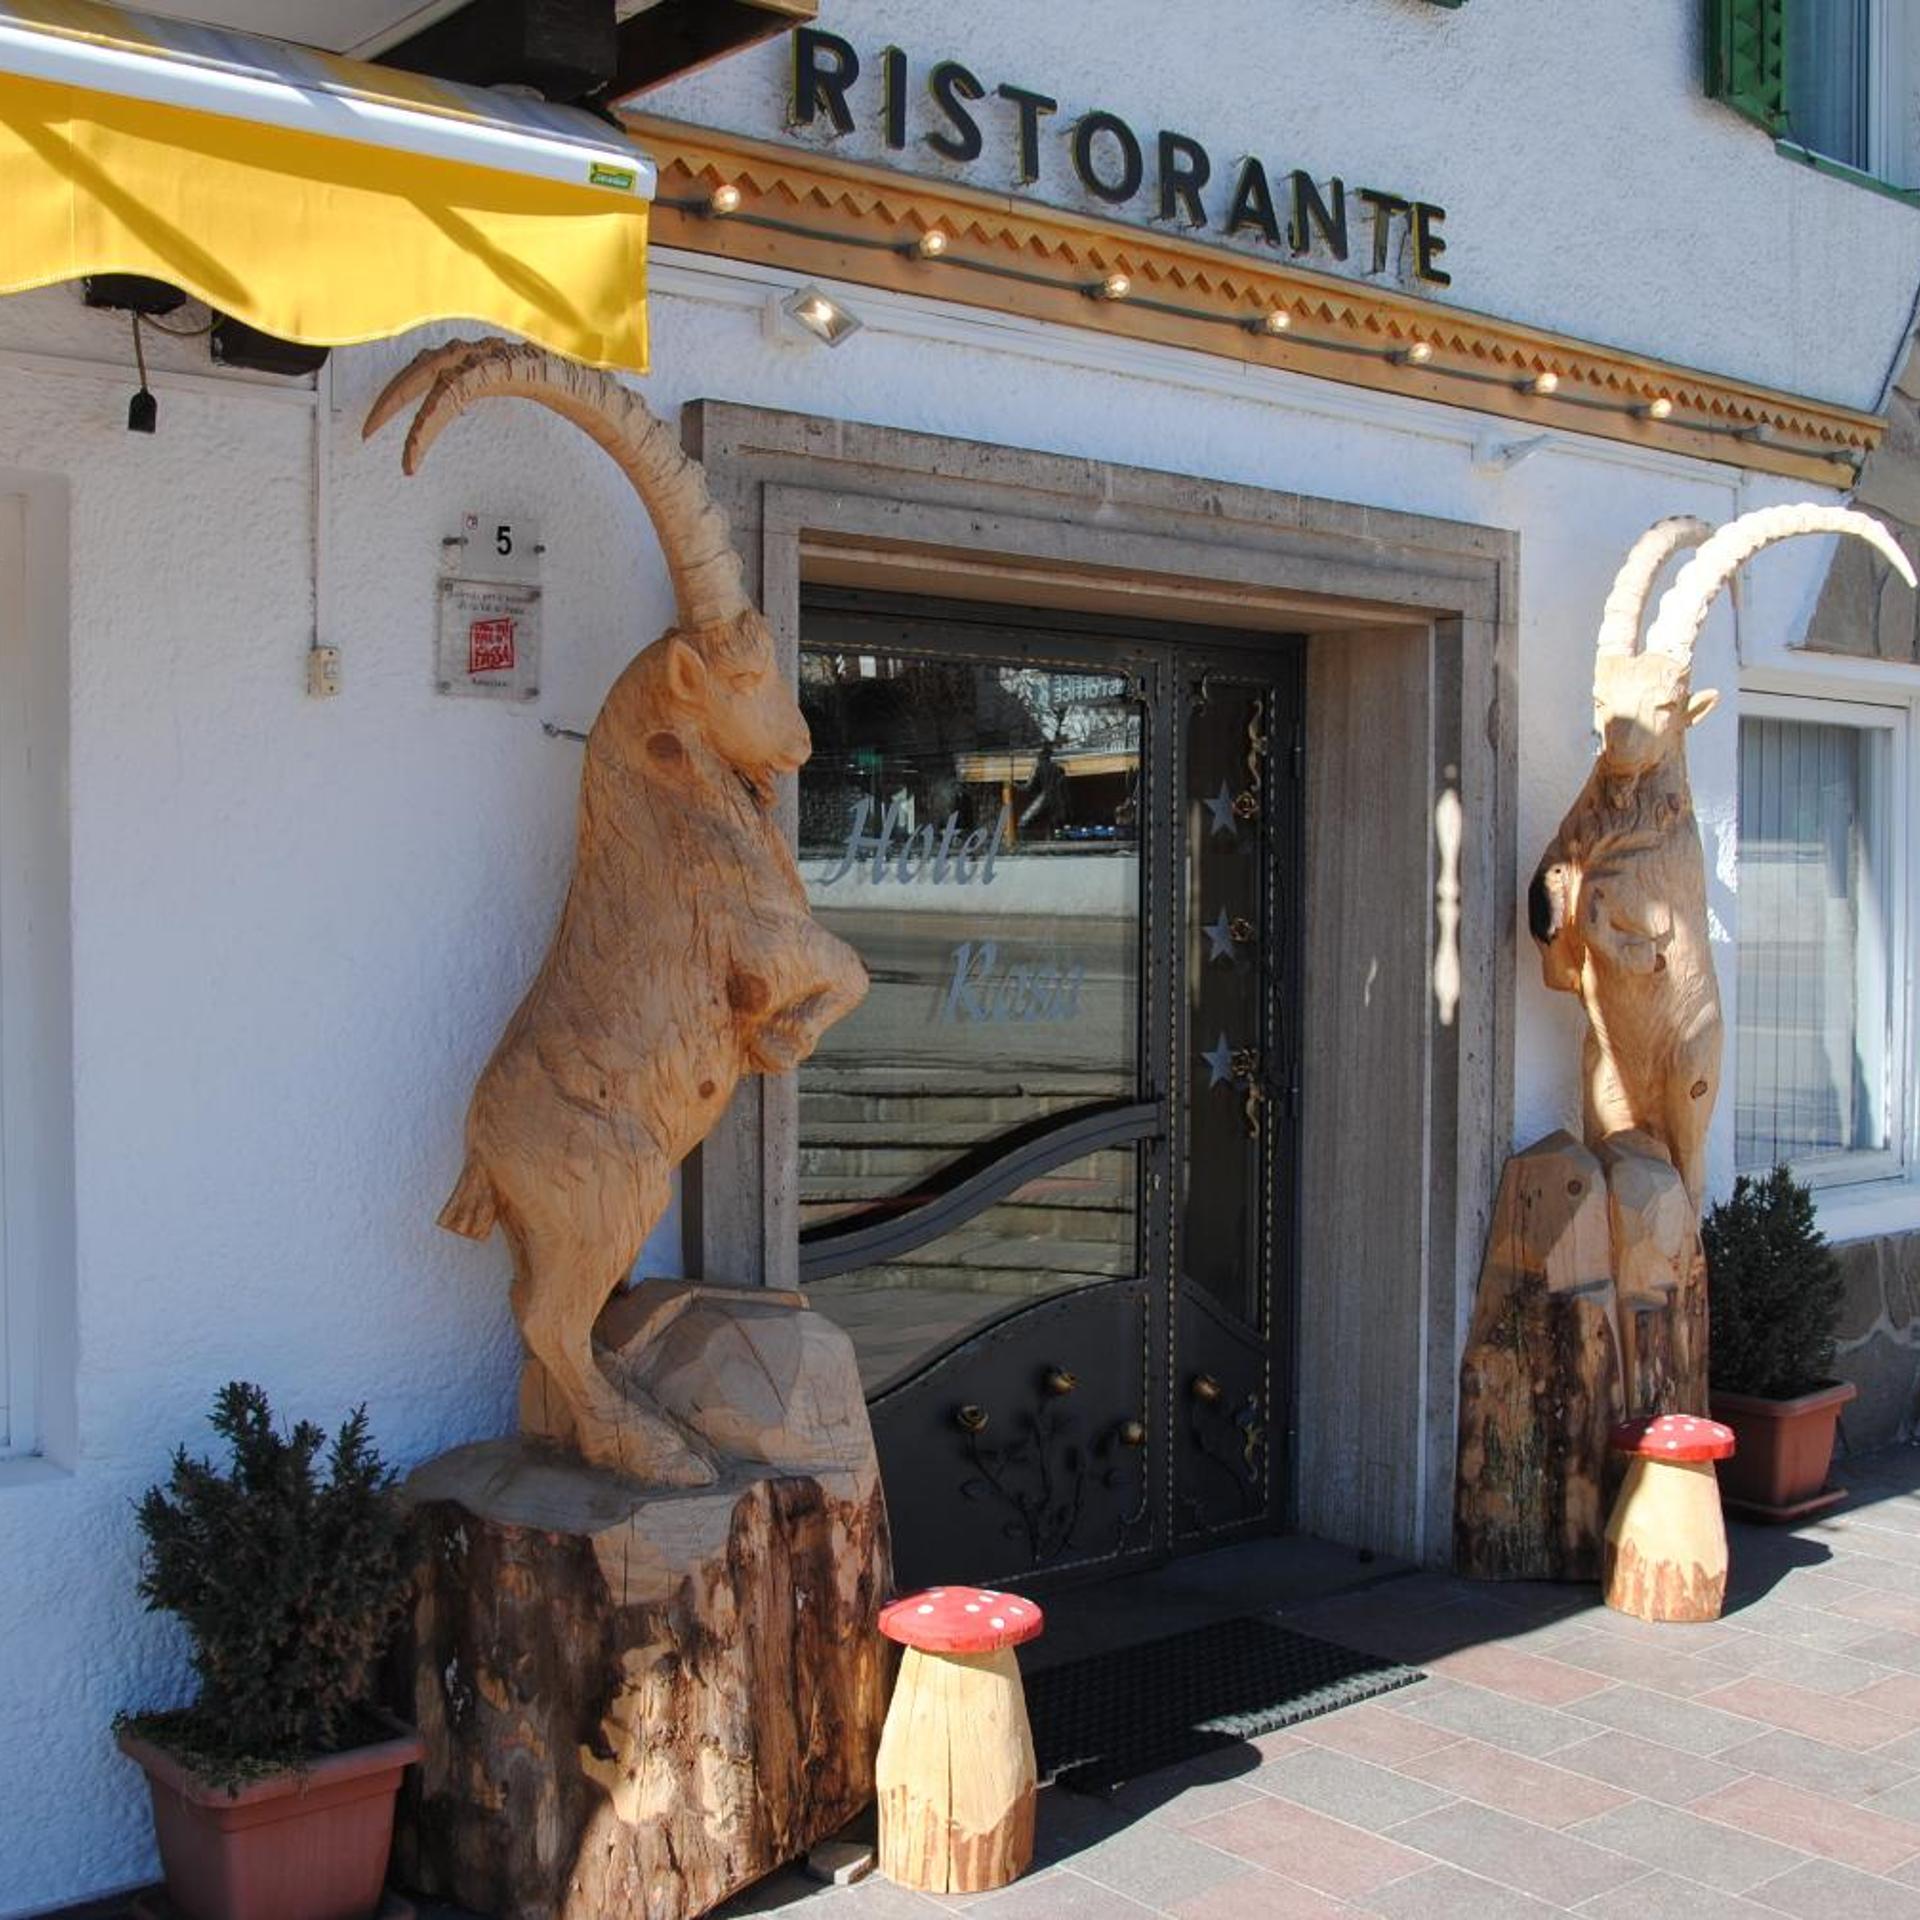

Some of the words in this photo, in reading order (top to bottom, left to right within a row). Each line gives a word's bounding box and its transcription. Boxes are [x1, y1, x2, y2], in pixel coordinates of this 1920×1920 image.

[793, 27, 1452, 286] RISTORANTE
[497, 525, 512, 556] 5
[818, 795, 1011, 886] Hotel
[944, 939, 1085, 1024] Rosa
